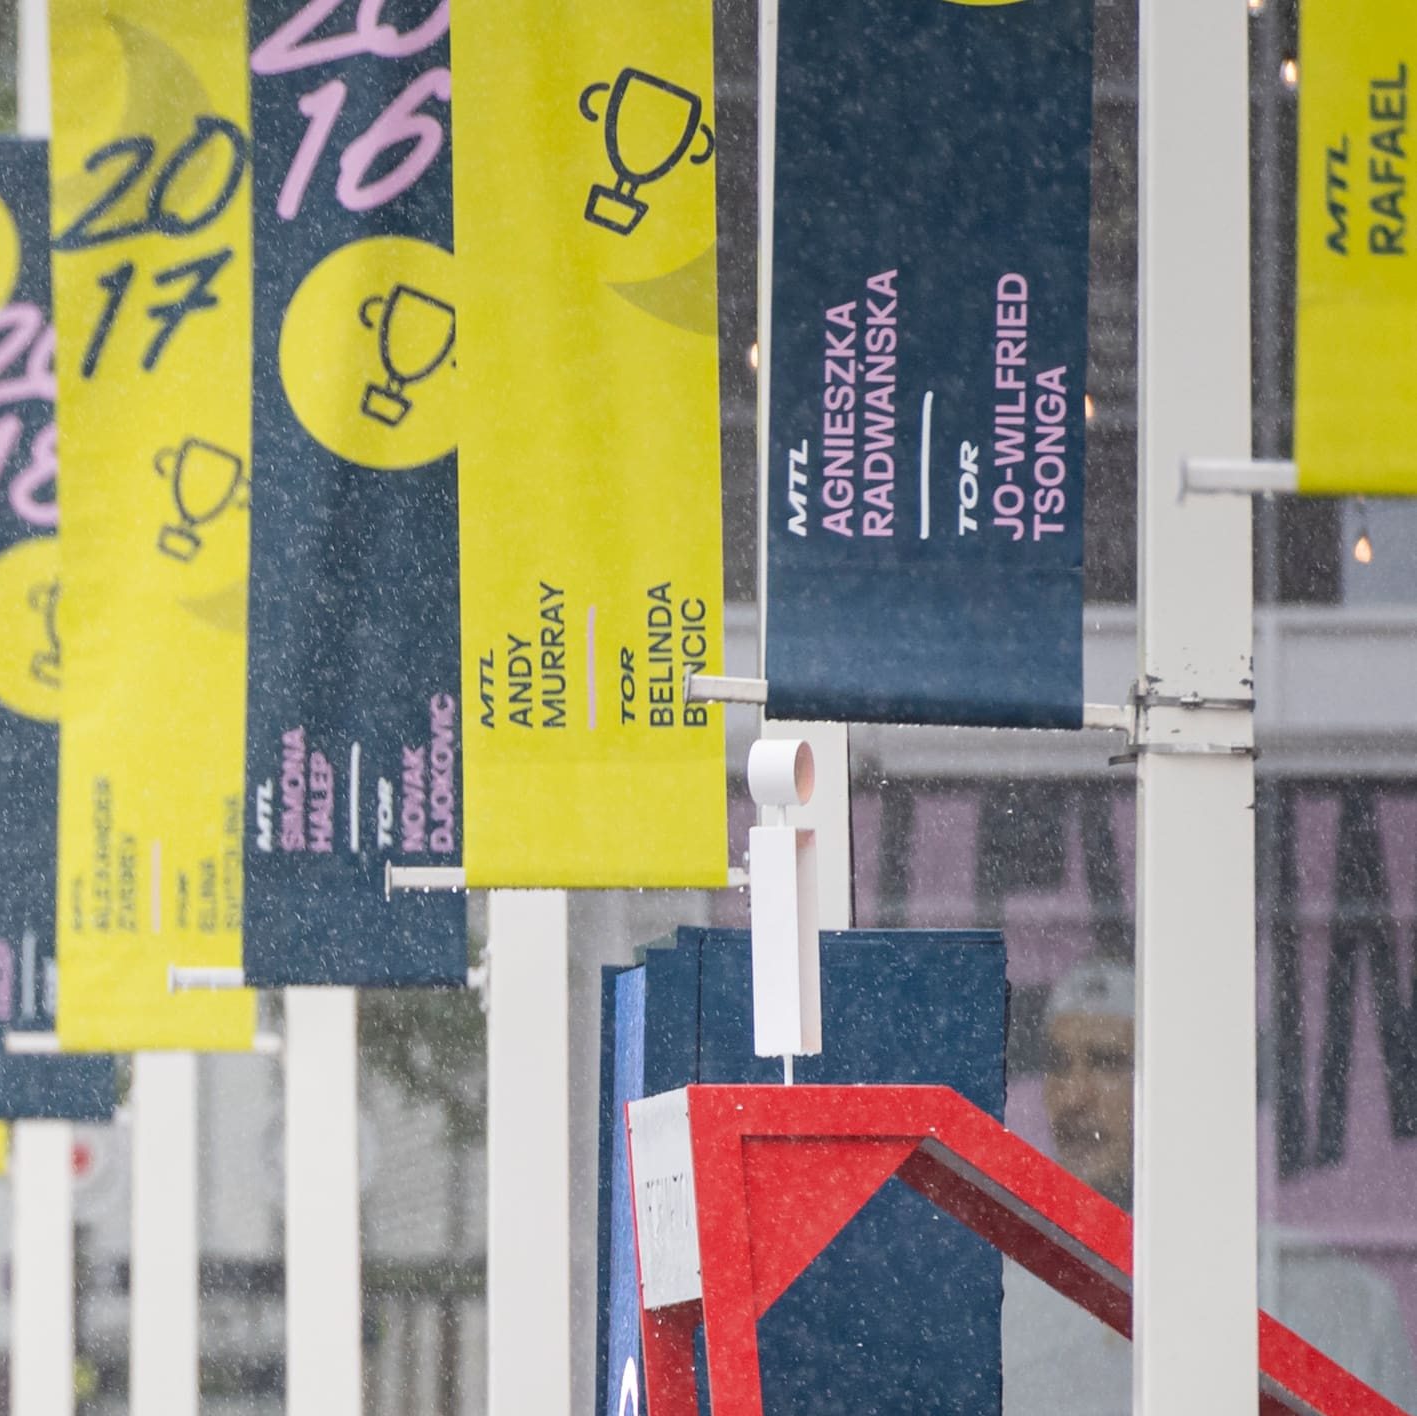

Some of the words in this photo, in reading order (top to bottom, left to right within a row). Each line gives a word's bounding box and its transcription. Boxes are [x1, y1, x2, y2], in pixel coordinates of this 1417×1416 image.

[51, 115, 248, 252] 20
[276, 66, 452, 220] 16
[1326, 132, 1349, 258] MTL
[1369, 60, 1408, 256] RAFAEL
[81, 248, 235, 378] 17
[821, 299, 857, 538] AGNIESZKA
[858, 267, 899, 538] RADWAŃSKA
[993, 272, 1029, 542] JO-WILFRIED
[1033, 364, 1068, 542] TSONGA
[787, 438, 809, 538] MTL
[958, 439, 979, 537] TOR
[479, 648, 495, 730] MTL
[507, 632, 534, 729] ANDY
[539, 580, 567, 729] MURRAY
[620, 645, 637, 726] TOR
[647, 580, 675, 728] BELINDA
[680, 598, 708, 728] BNCIC
[256, 777, 274, 852] MTL
[281, 724, 307, 852] SIMONA
[309, 749, 334, 853] HALEP
[377, 776, 394, 849] TOR
[401, 743, 426, 853] NOVAK
[430, 692, 456, 853] DJOKOVIC
